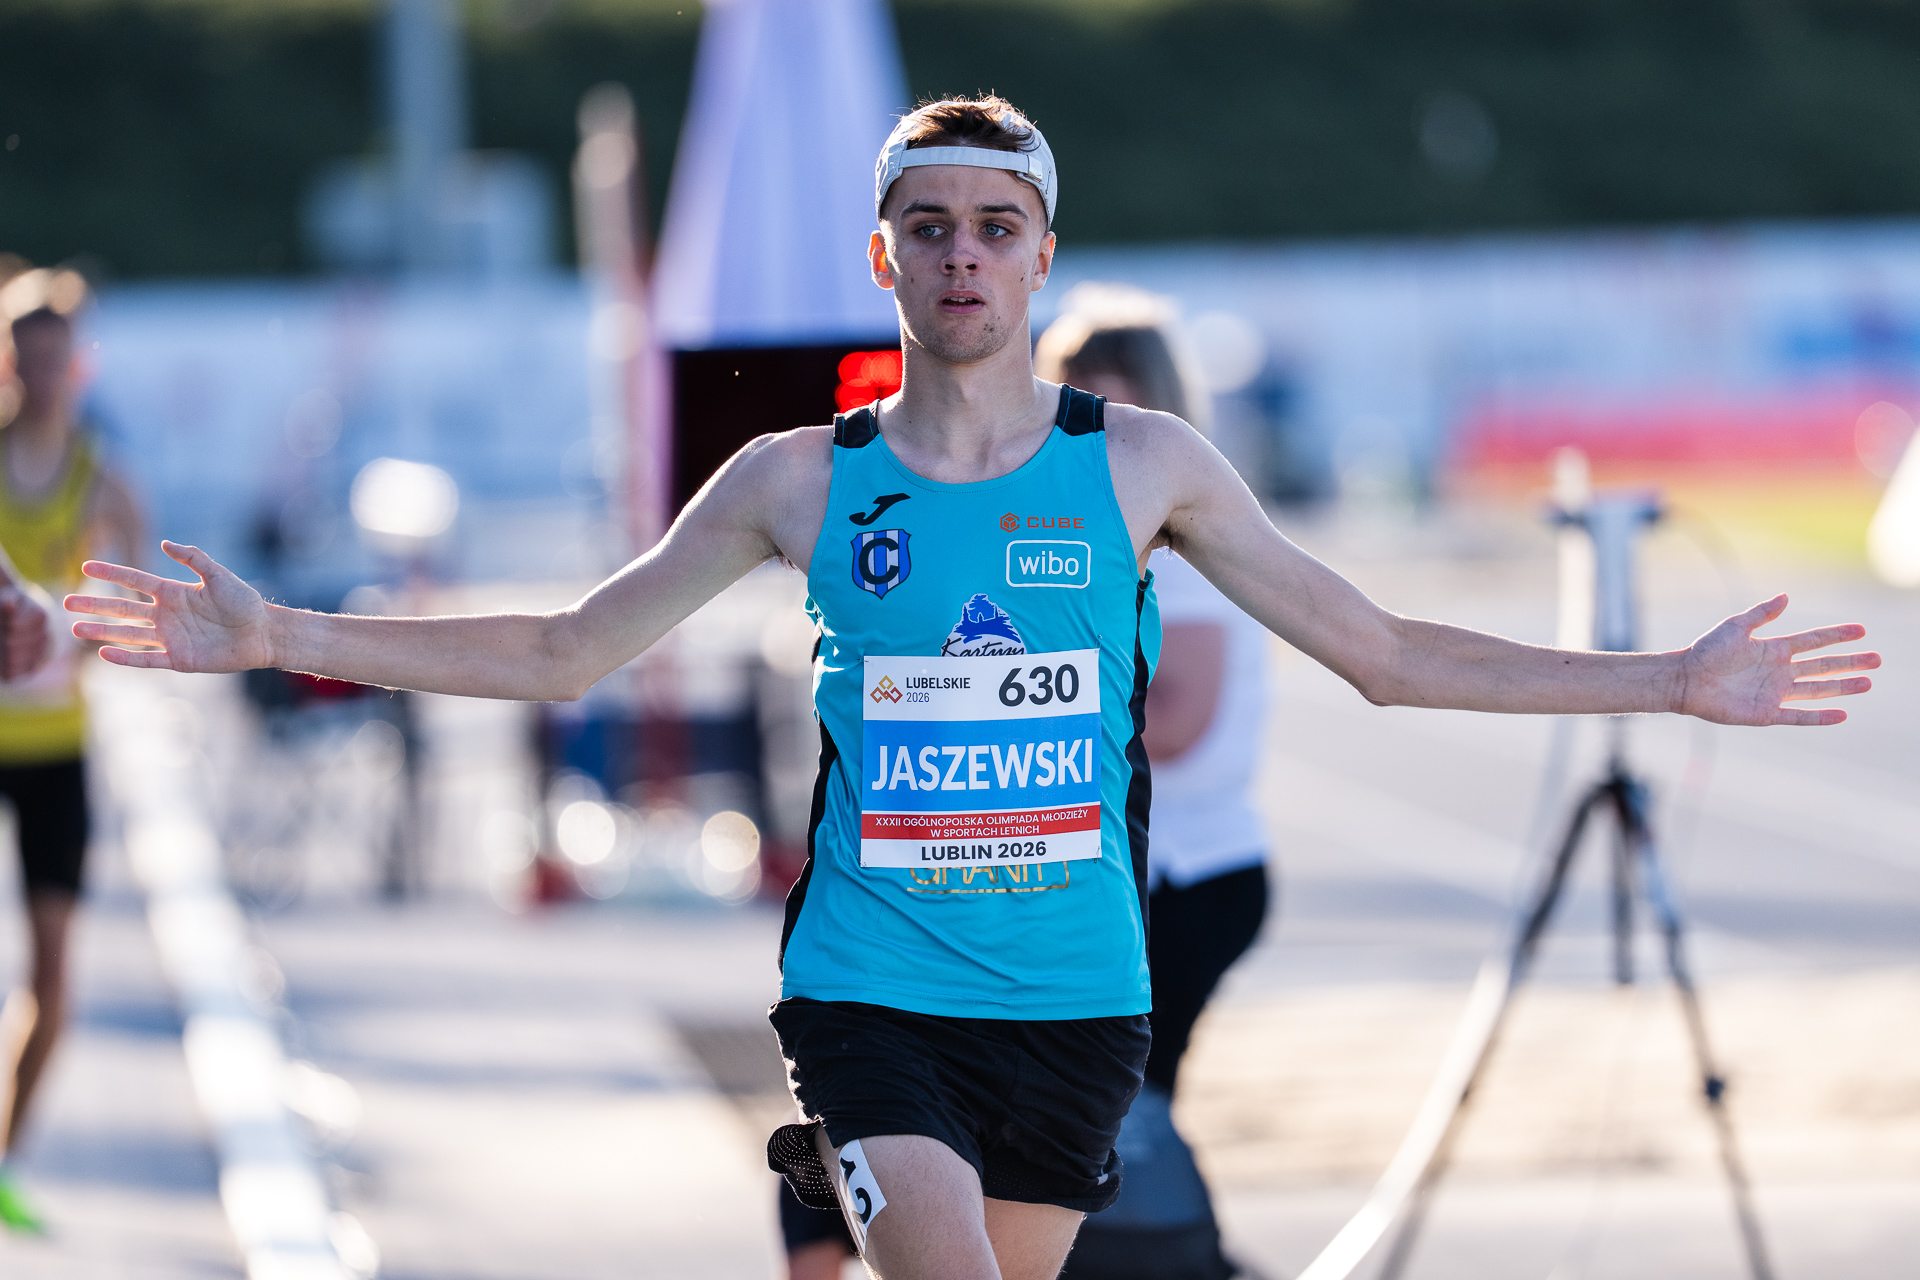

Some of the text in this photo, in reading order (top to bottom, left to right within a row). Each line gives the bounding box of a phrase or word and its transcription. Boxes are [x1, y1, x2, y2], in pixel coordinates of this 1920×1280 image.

[1027, 516, 1085, 529] CUBE
[858, 537, 900, 585] C
[1018, 550, 1080, 576] wibo
[906, 677, 971, 689] LUBELSKIE
[998, 663, 1080, 707] 630
[906, 691, 930, 703] 2026
[871, 738, 1093, 791] JASZEWSKI
[875, 808, 1089, 827] XXXII OGÓLNOPOLSKA OLIMPIADA MŁODZIEŻY
[930, 825, 1040, 838] W SPORTACH LETNICH
[921, 841, 1047, 861] LUBLIN 2026
